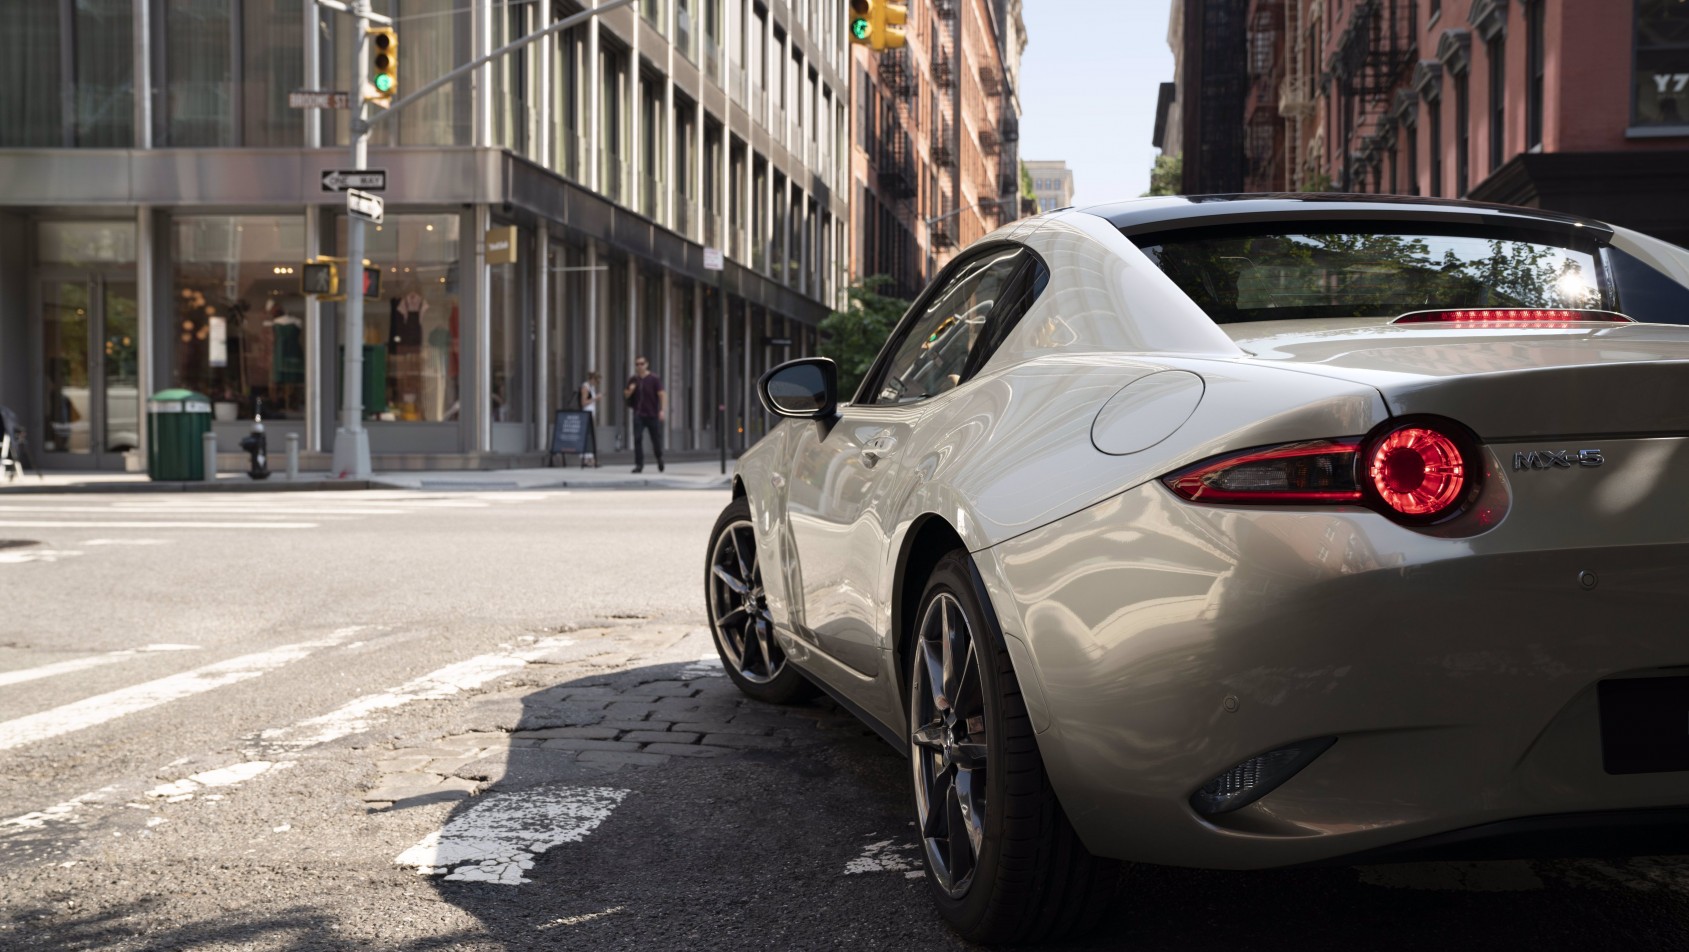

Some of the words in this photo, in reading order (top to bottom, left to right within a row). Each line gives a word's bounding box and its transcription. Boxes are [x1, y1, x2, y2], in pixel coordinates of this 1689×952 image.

[289, 93, 328, 108] BROOME
[334, 94, 347, 109] ST
[329, 175, 347, 186] ONE
[360, 175, 381, 187] WAY
[1513, 449, 1604, 469] MX-5
